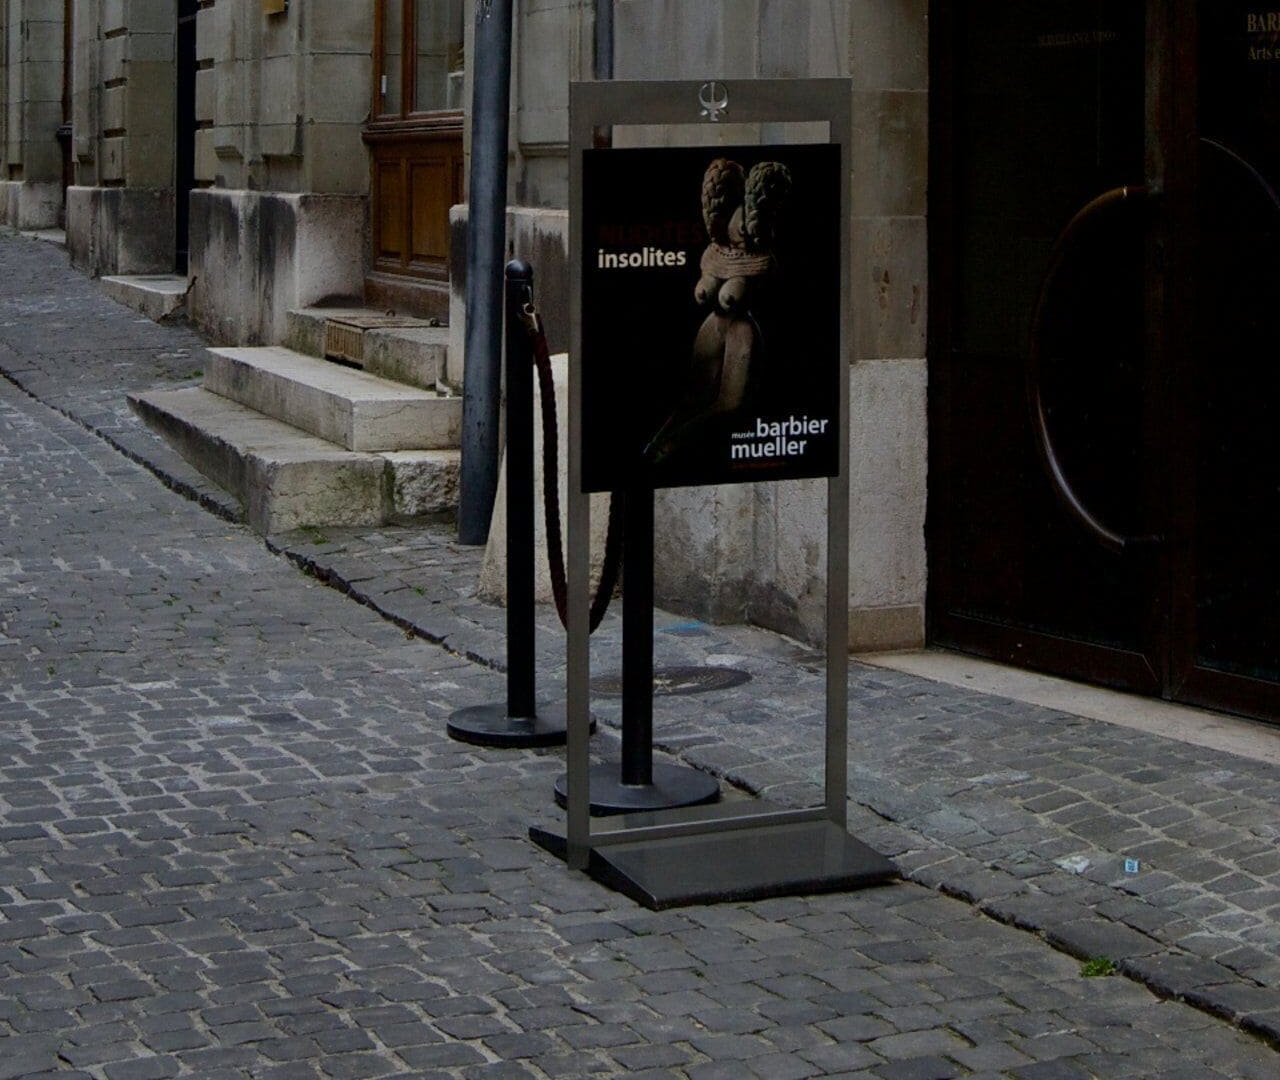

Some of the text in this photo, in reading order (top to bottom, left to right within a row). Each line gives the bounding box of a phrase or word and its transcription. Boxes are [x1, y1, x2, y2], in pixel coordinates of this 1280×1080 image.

[598, 247, 687, 269] insolites
[756, 415, 829, 438] barbier
[730, 436, 808, 460] mueller
